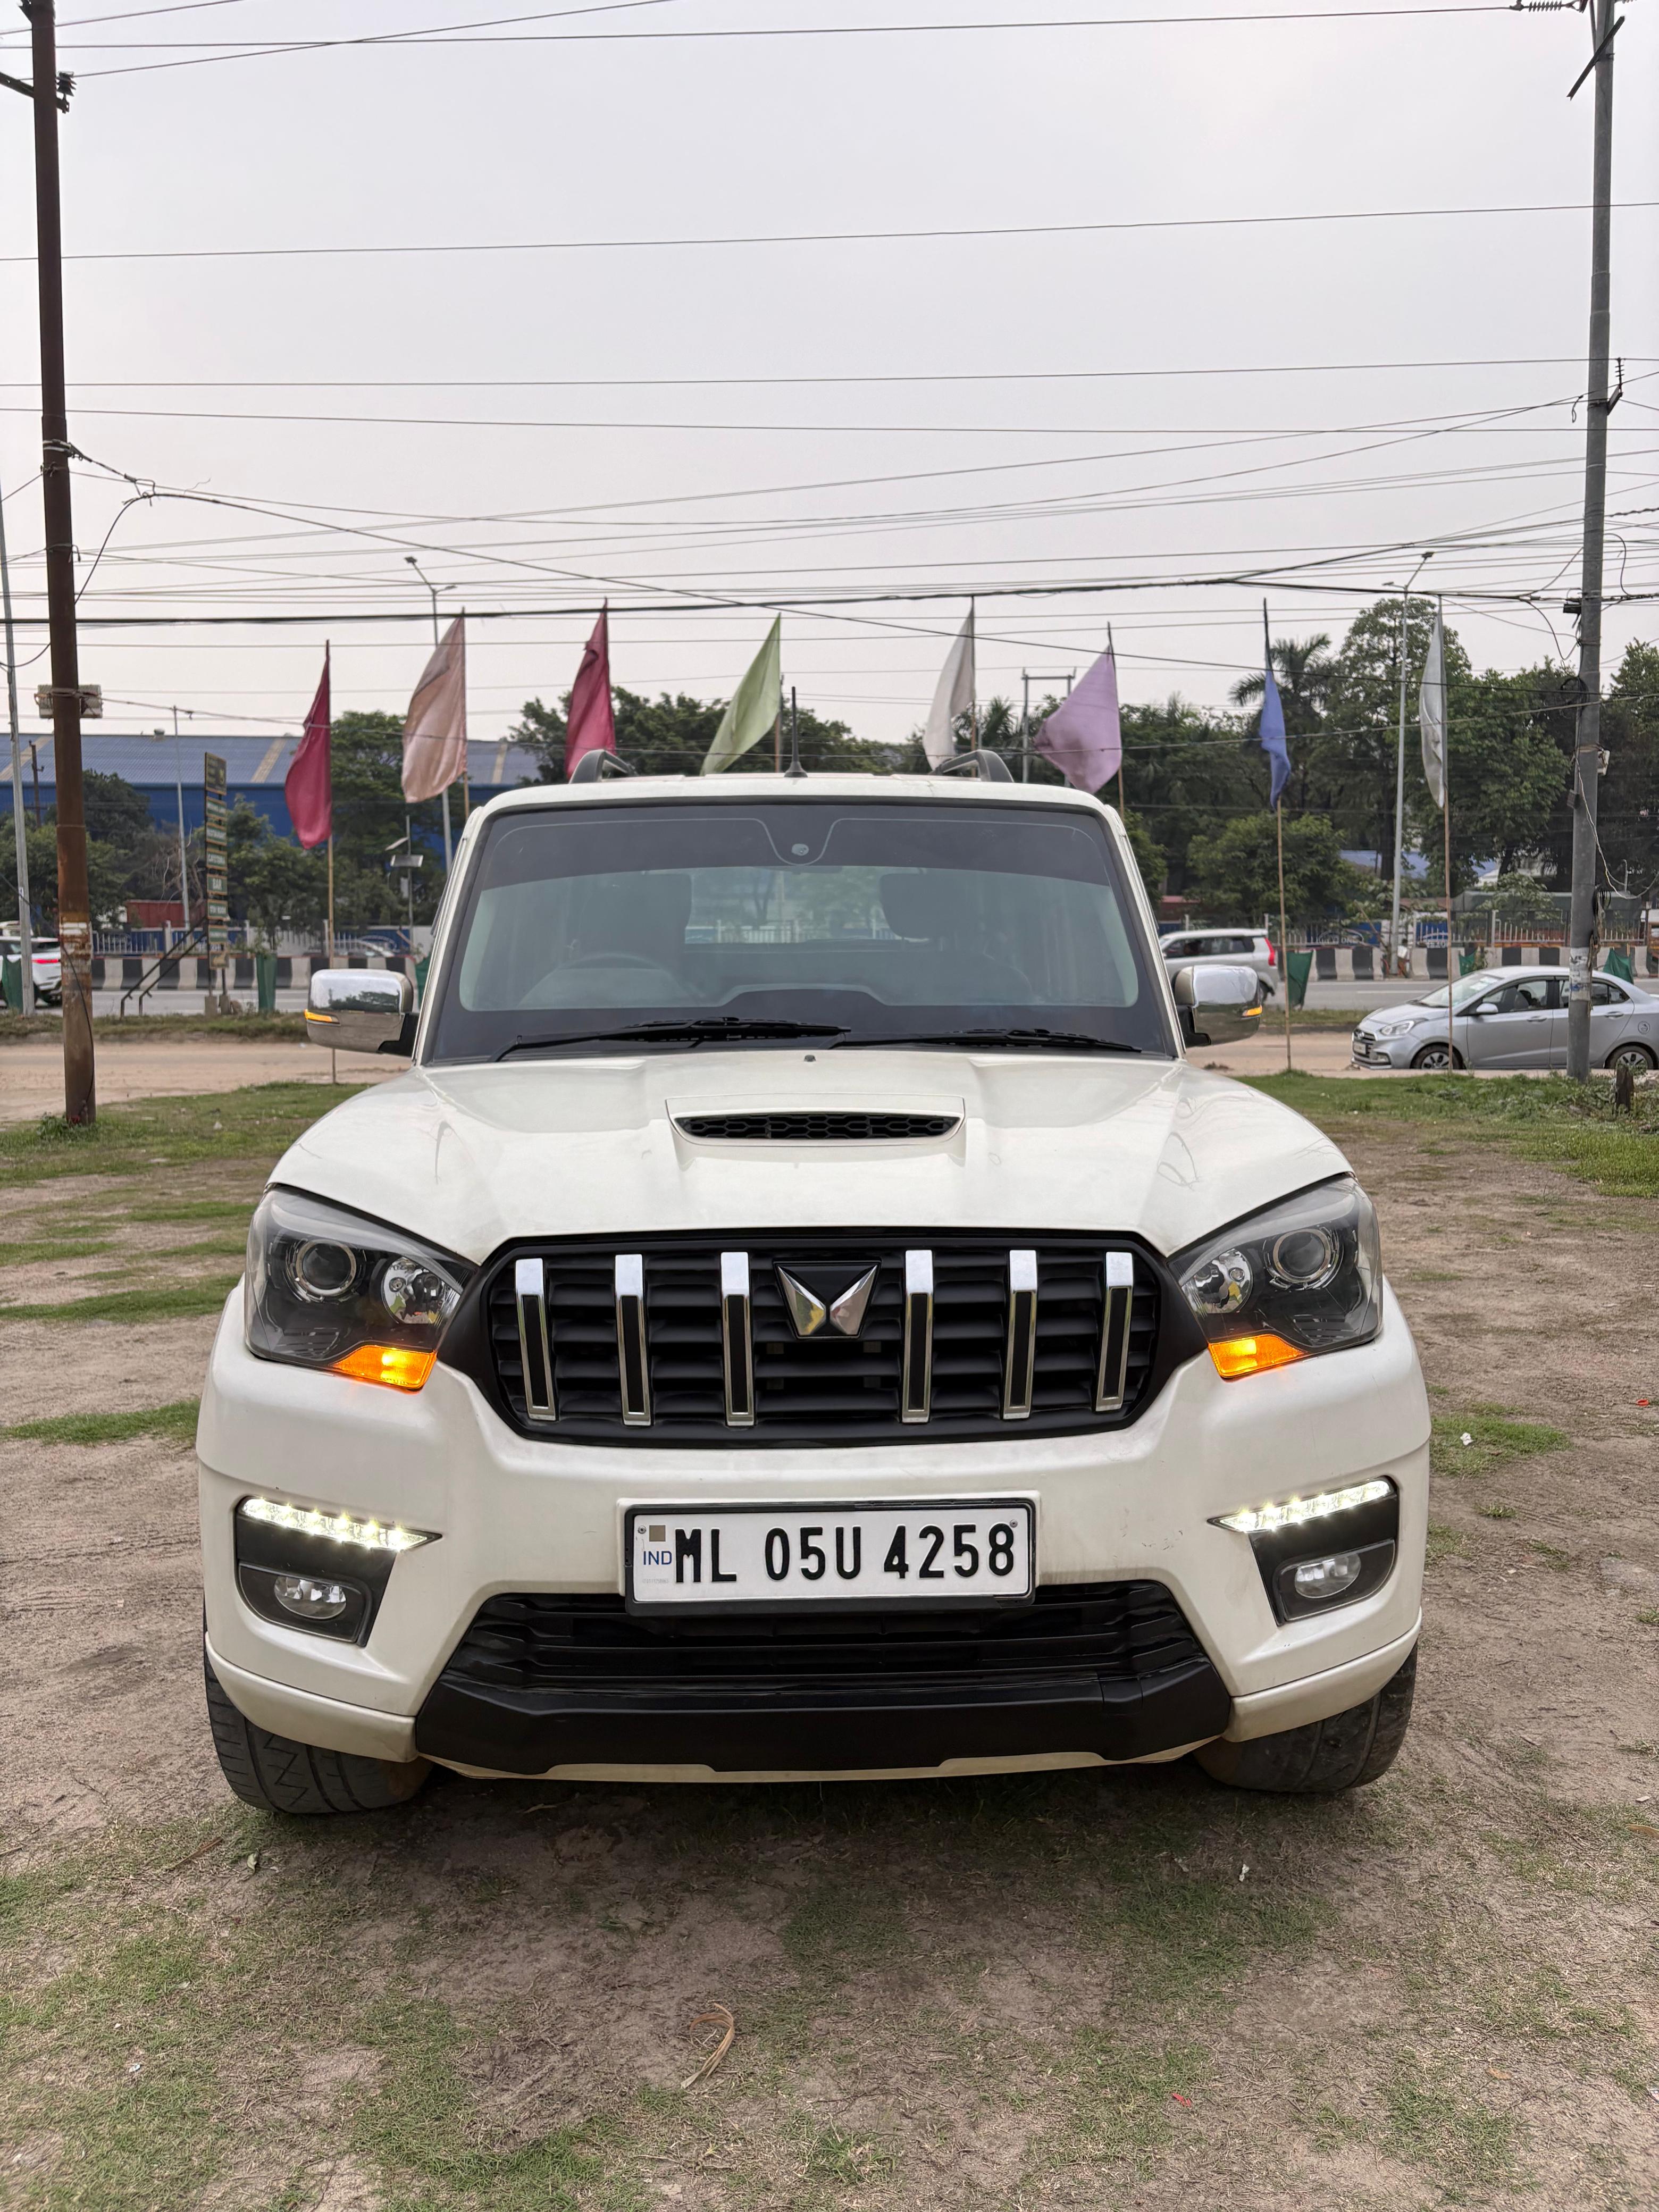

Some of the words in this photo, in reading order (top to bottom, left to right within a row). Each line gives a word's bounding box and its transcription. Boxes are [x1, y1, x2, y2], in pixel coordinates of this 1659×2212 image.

[643, 1551, 672, 1565] IND
[675, 1529, 737, 1583] ML
[765, 1526, 861, 1581] 05U
[884, 1523, 1014, 1579] 4258
